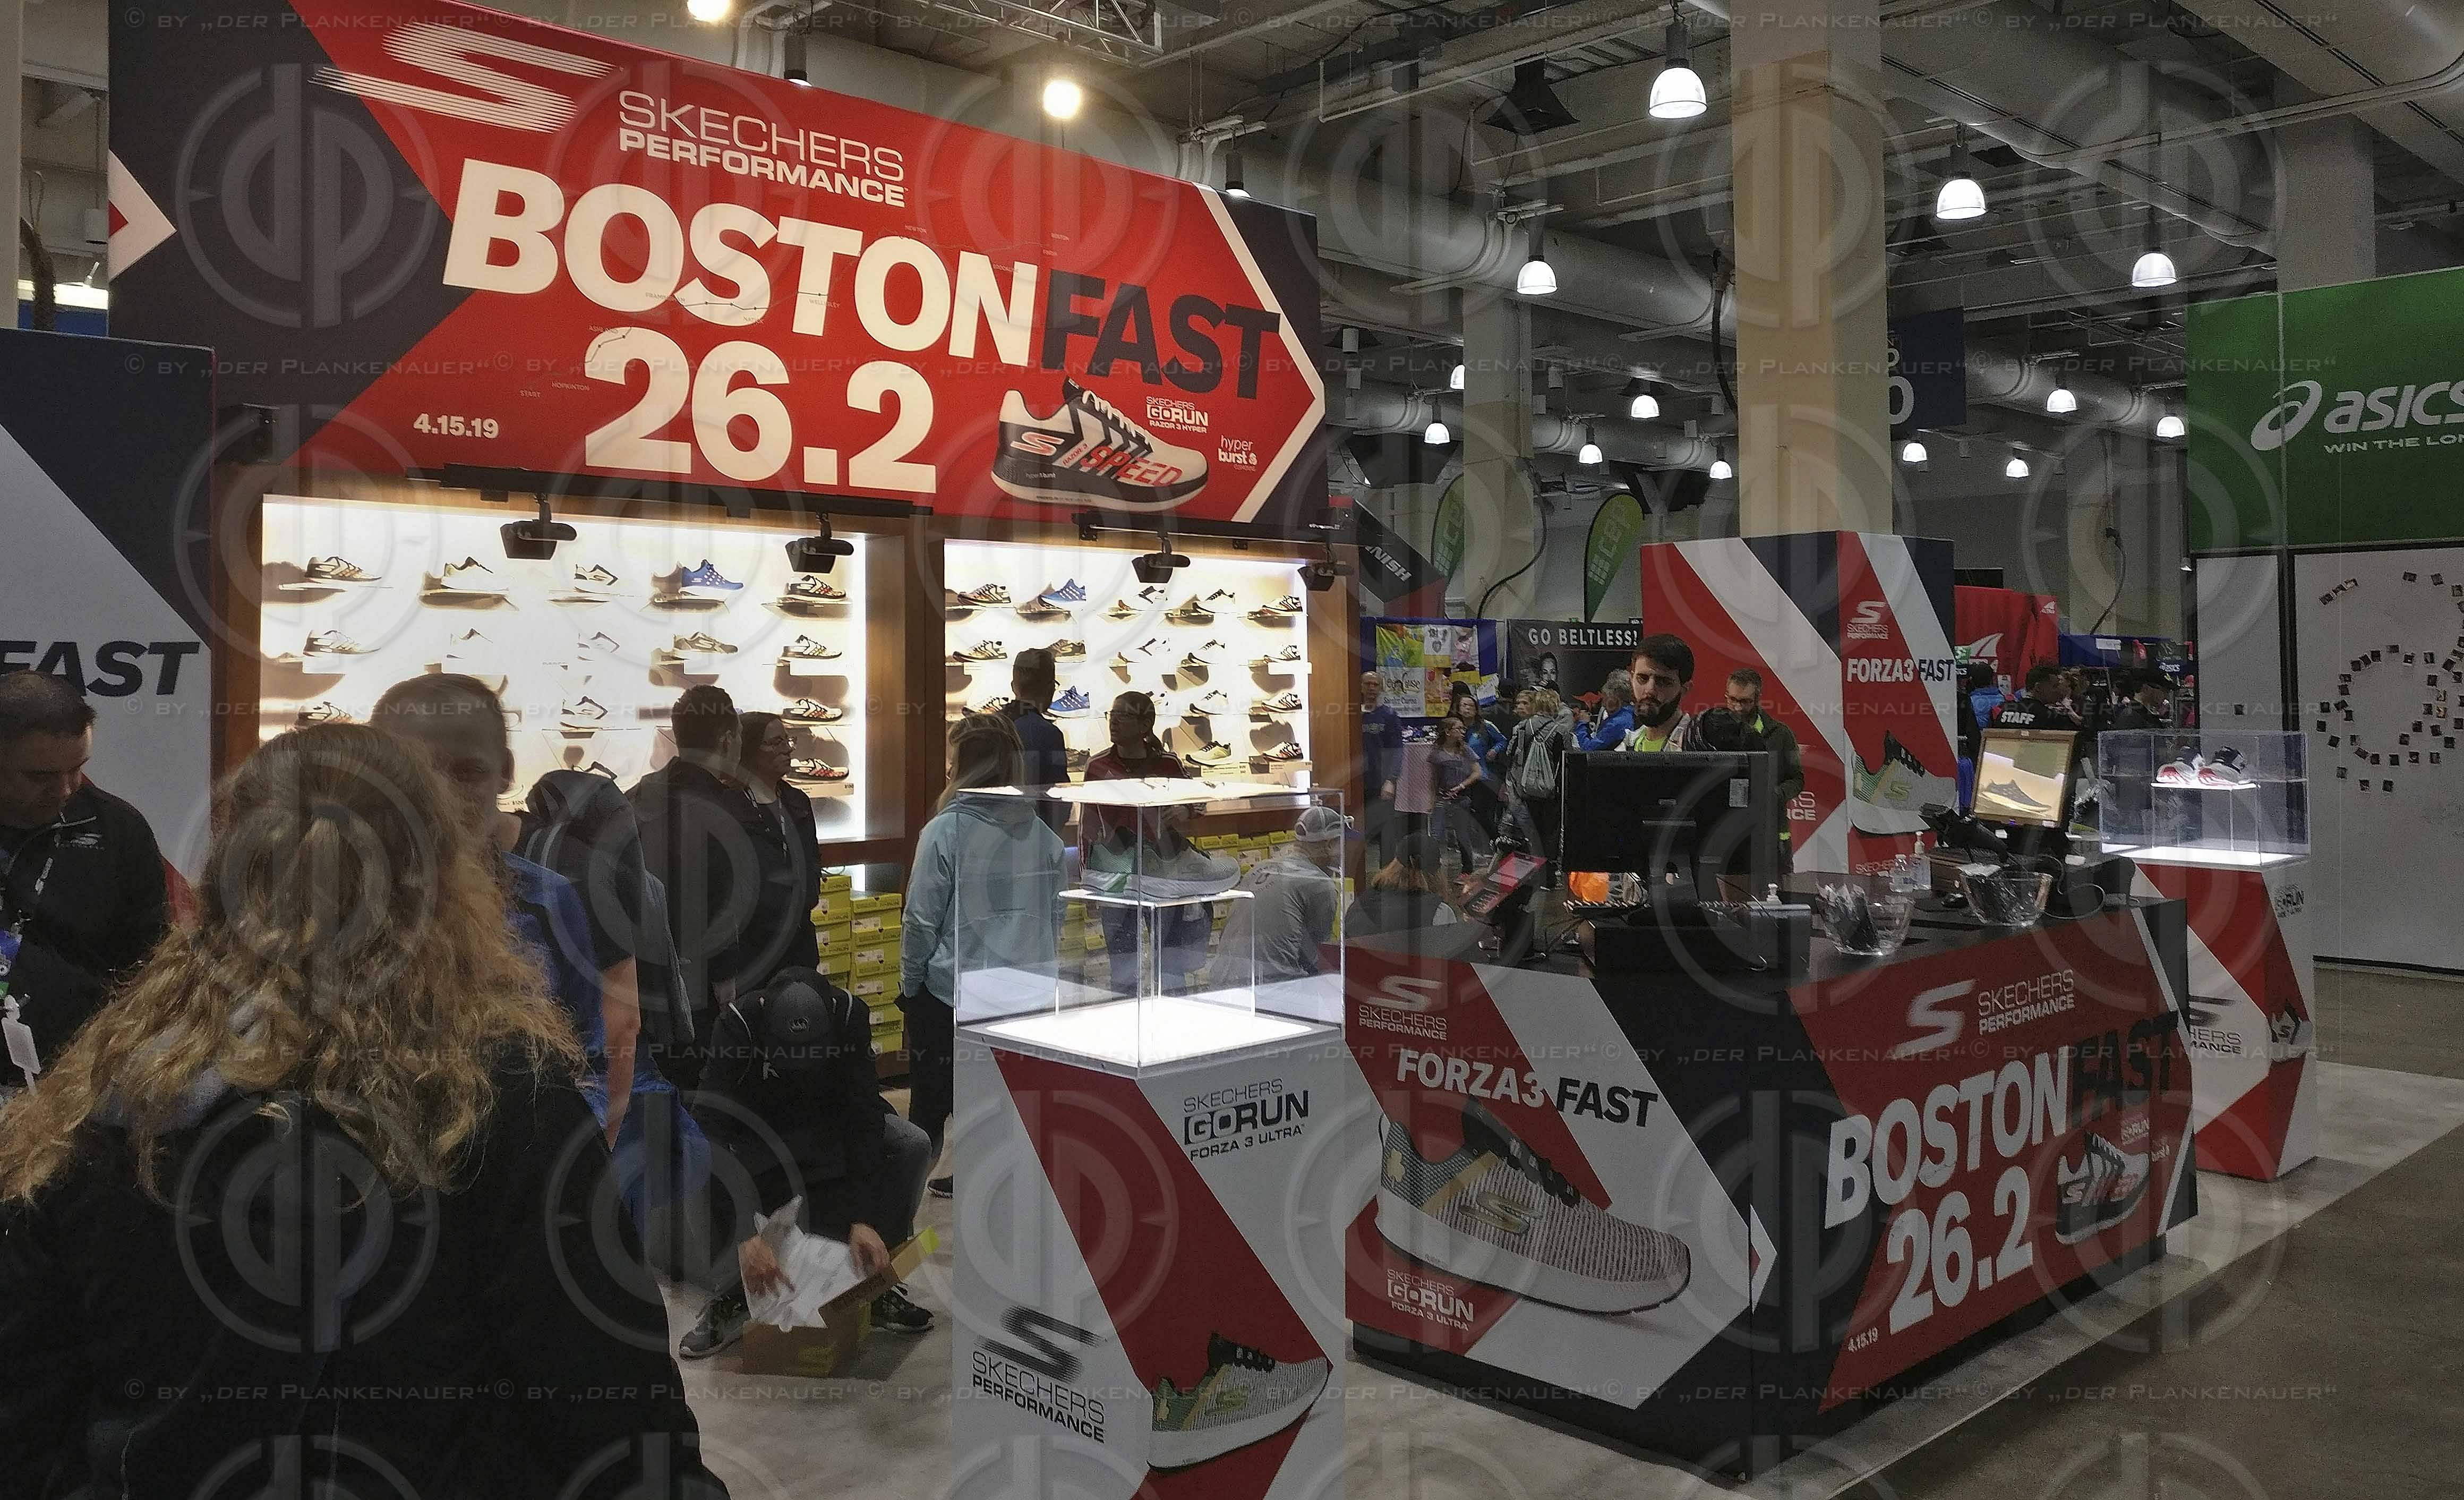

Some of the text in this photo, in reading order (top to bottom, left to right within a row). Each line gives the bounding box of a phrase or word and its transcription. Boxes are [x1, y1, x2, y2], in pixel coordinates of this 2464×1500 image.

[619, 90, 904, 182] SKECHERS
[619, 128, 905, 208] PERFORMANCE
[585, 326, 937, 493] 26.2
[1146, 396, 1195, 410] SKECHERS
[413, 413, 499, 439] 4.15.19
[1149, 420, 1176, 430] RAZOR
[1221, 434, 1254, 452] hyper
[2324, 441, 2367, 454] WIN
[2373, 437, 2421, 450] THE
[1080, 446, 1183, 487] SPEED
[1528, 627, 1638, 646] GO BELTLESS!
[1846, 658, 1915, 683] FORZA3
[1918, 658, 1954, 682] FAST
[2000, 711, 2036, 725] STAFF
[1978, 969, 2075, 1017] SKECHERS
[1358, 1004, 1448, 1030] SKECHERS
[1358, 1017, 1448, 1042] PERFORMANCE
[1979, 993, 2075, 1035] PERFORMANCE
[1183, 1078, 1283, 1113] SKECHERS
[1397, 1049, 1658, 1128] FORZA3 FAST
[1190, 1125, 1303, 1162] FORZA 3 ULTRA
[1887, 1165, 2033, 1336] 26.2
[1387, 1268, 1455, 1296] SKECHERS
[1391, 1300, 1424, 1318] FORZA
[1436, 1315, 1469, 1331] ULTRA
[972, 1350, 1105, 1424] SKECHERS
[972, 1374, 1105, 1444] PERFORMANCE
